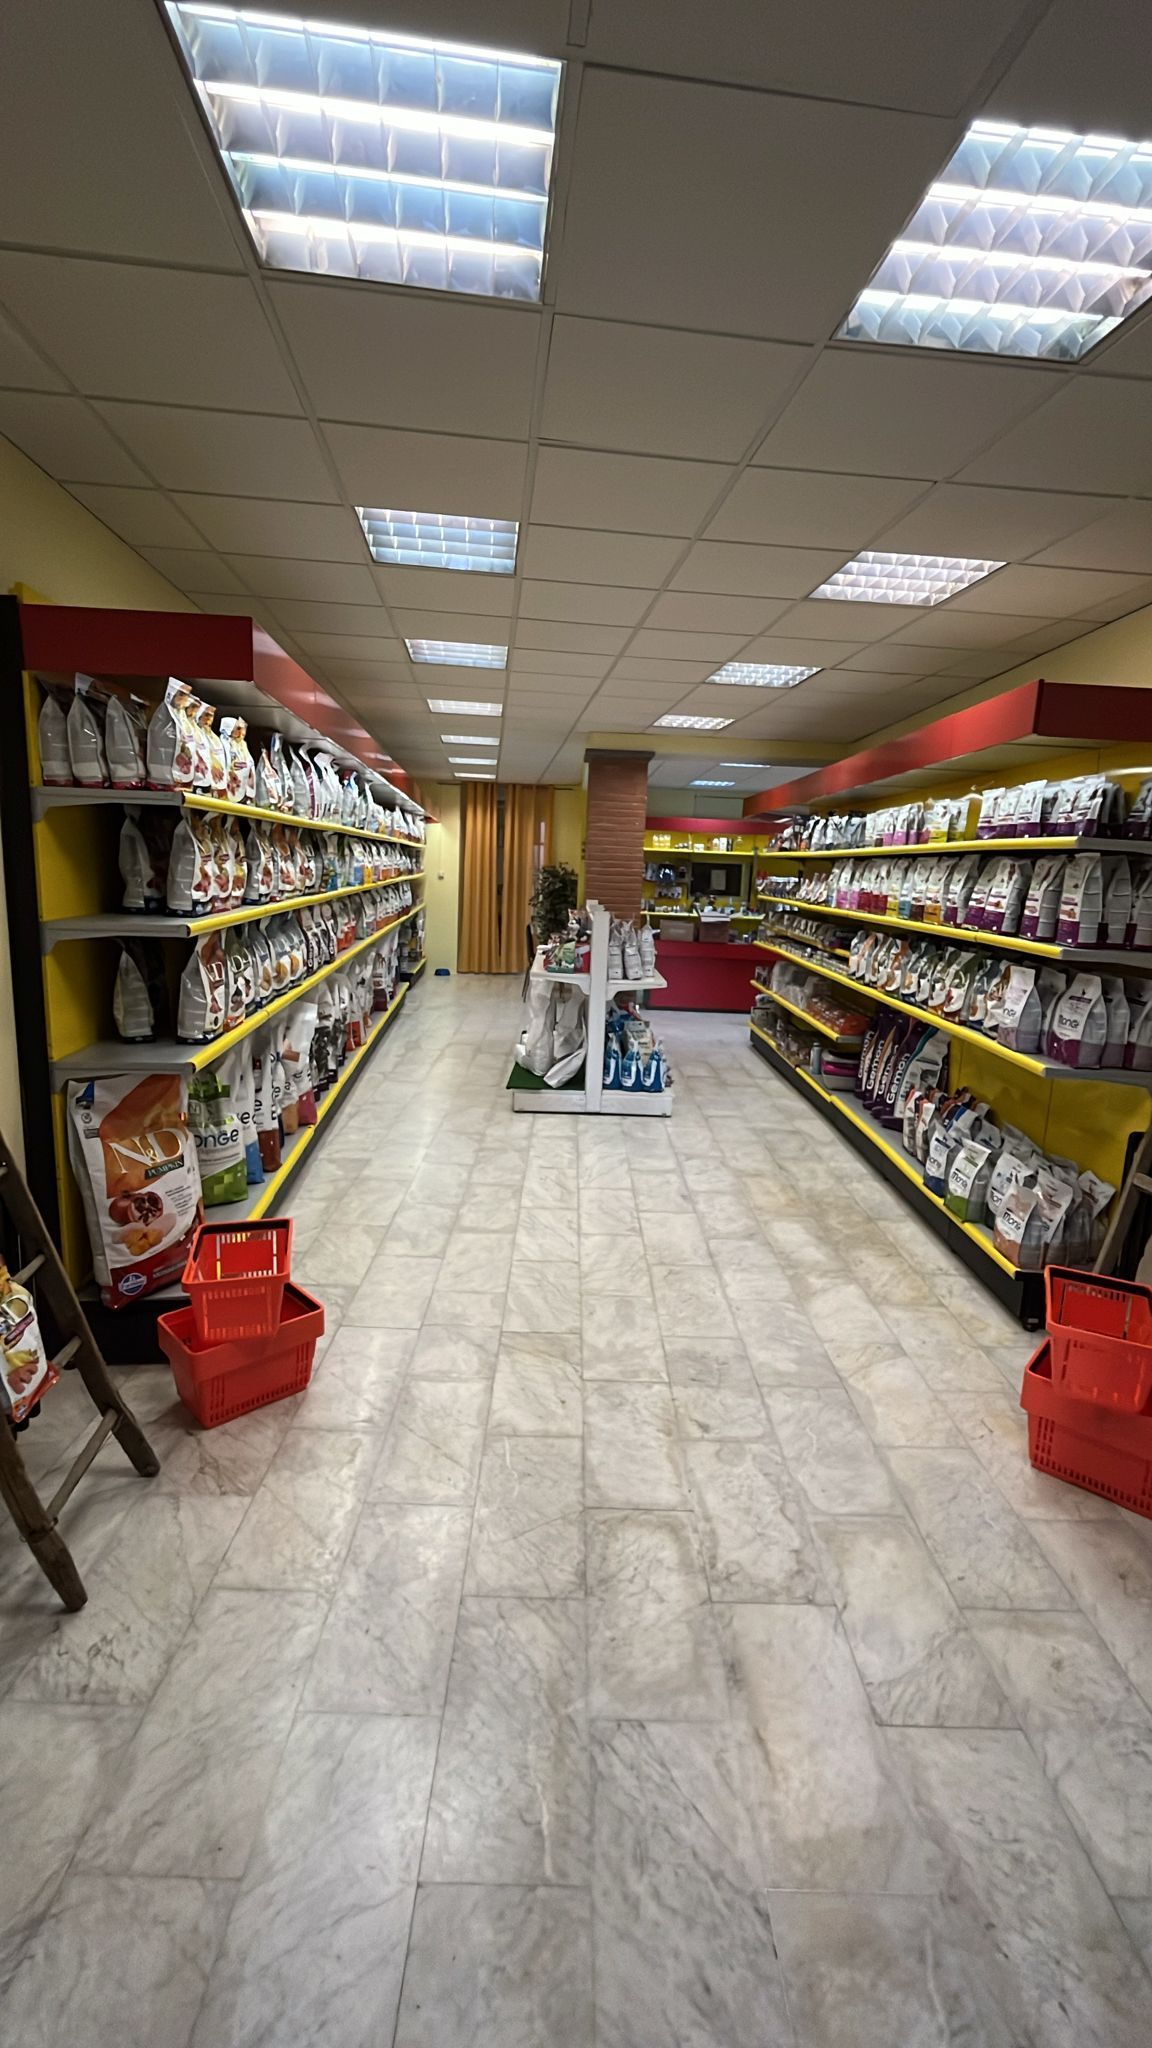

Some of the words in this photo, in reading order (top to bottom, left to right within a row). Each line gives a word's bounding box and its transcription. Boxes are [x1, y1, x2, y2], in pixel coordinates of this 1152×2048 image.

[866, 1040, 885, 1090] Gemon
[886, 1052, 911, 1104] Gemon
[109, 1127, 184, 1174] N&D
[148, 1157, 184, 1178] PUMPKIN
